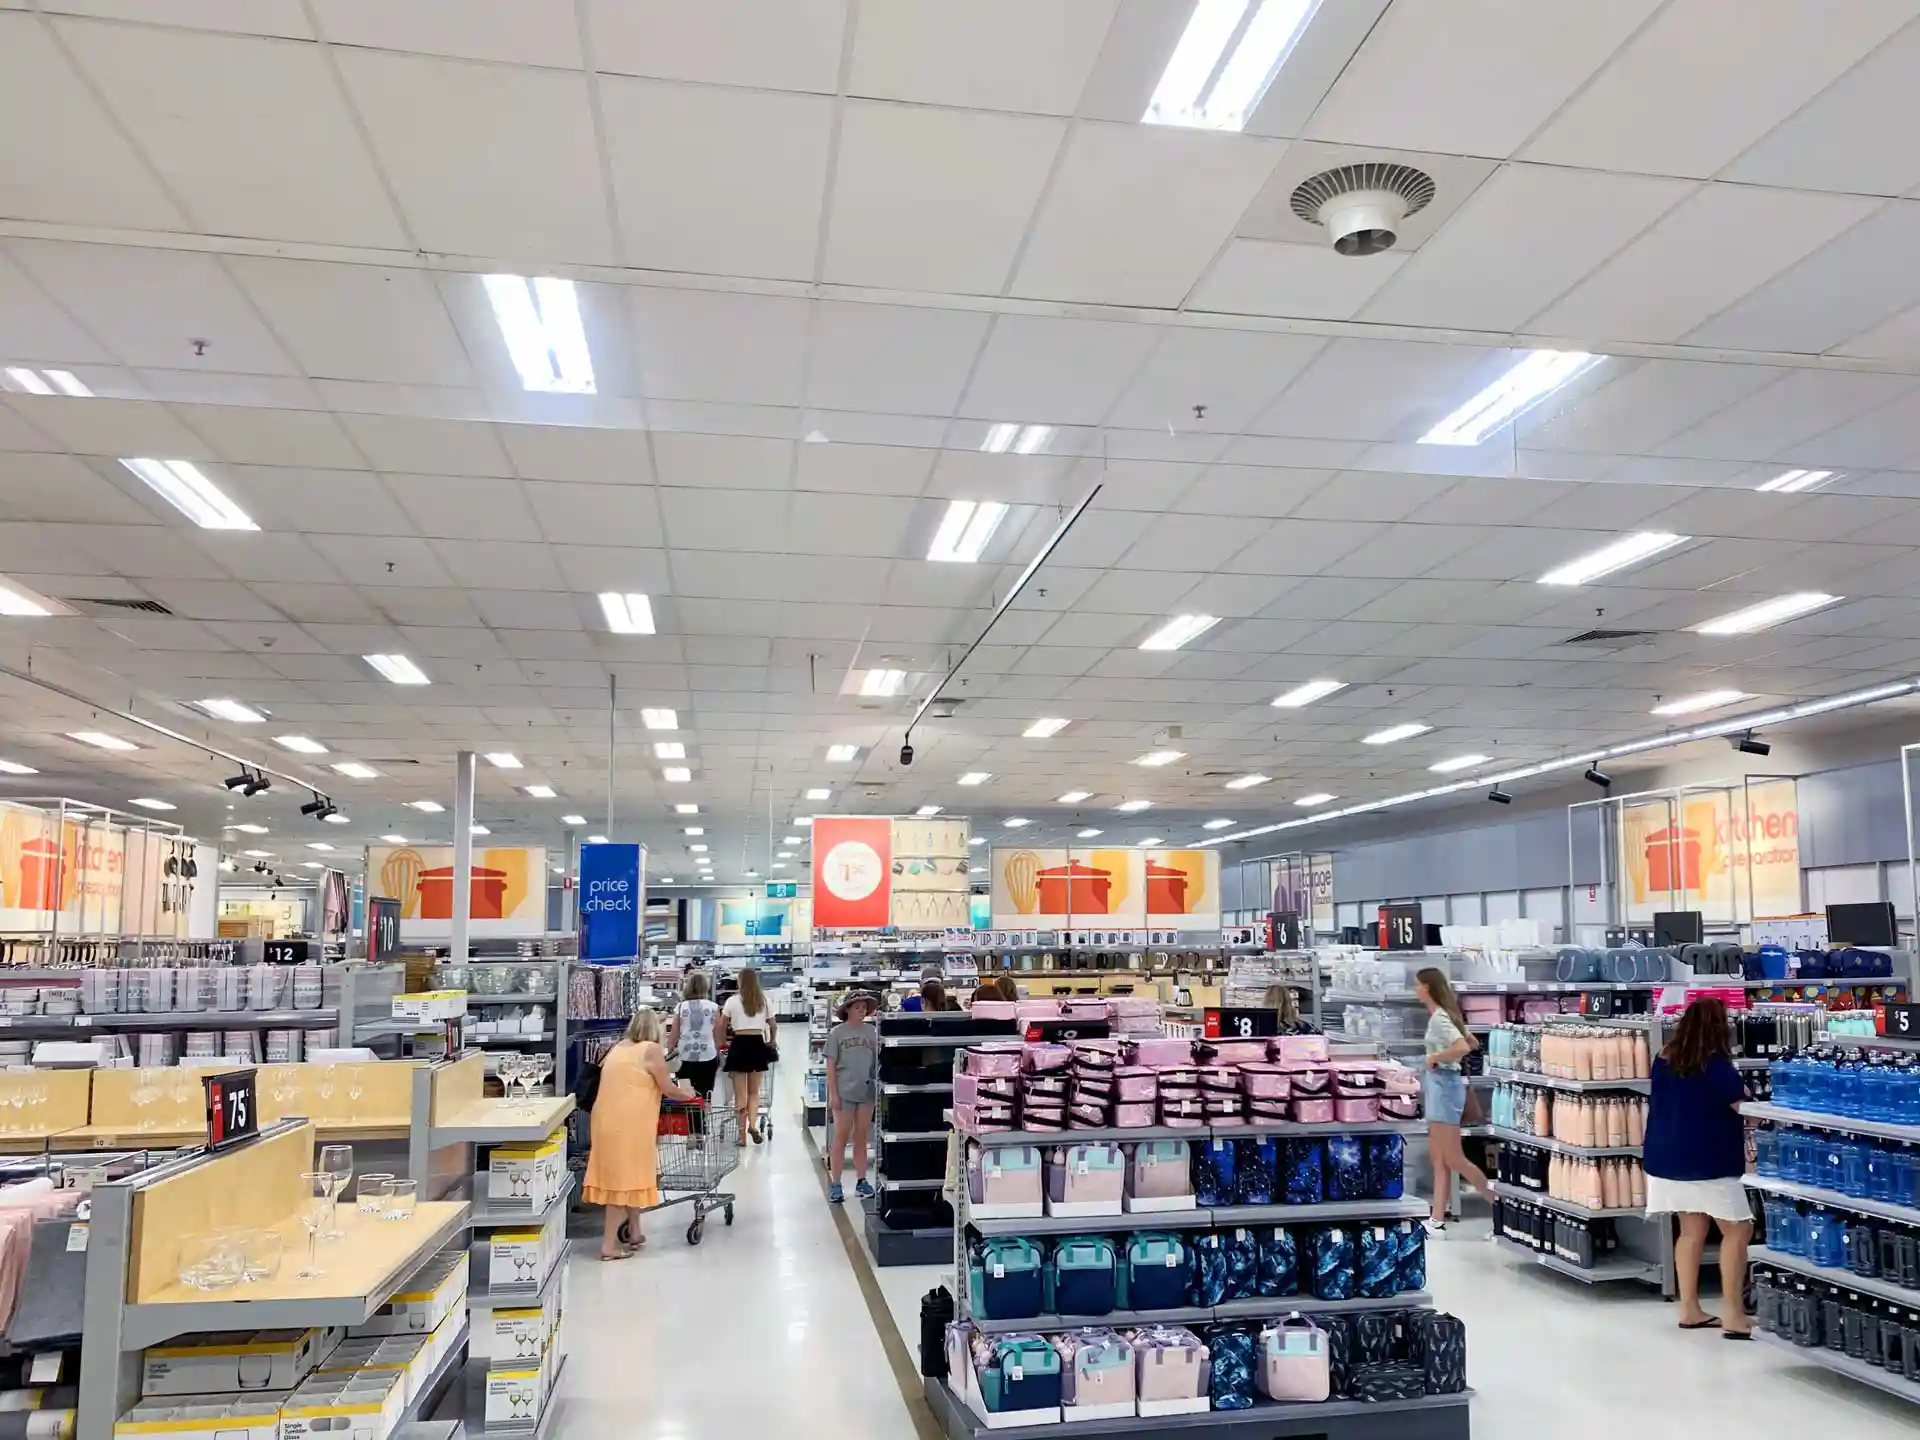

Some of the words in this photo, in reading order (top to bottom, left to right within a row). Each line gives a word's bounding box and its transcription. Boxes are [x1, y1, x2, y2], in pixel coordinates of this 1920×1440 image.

[590, 878, 629, 897] price
[586, 895, 632, 912] check
[1277, 922, 1287, 945] $6
[1393, 917, 1413, 944] $15
[1234, 1017, 1252, 1037] $8
[1895, 1010, 1909, 1032] $5
